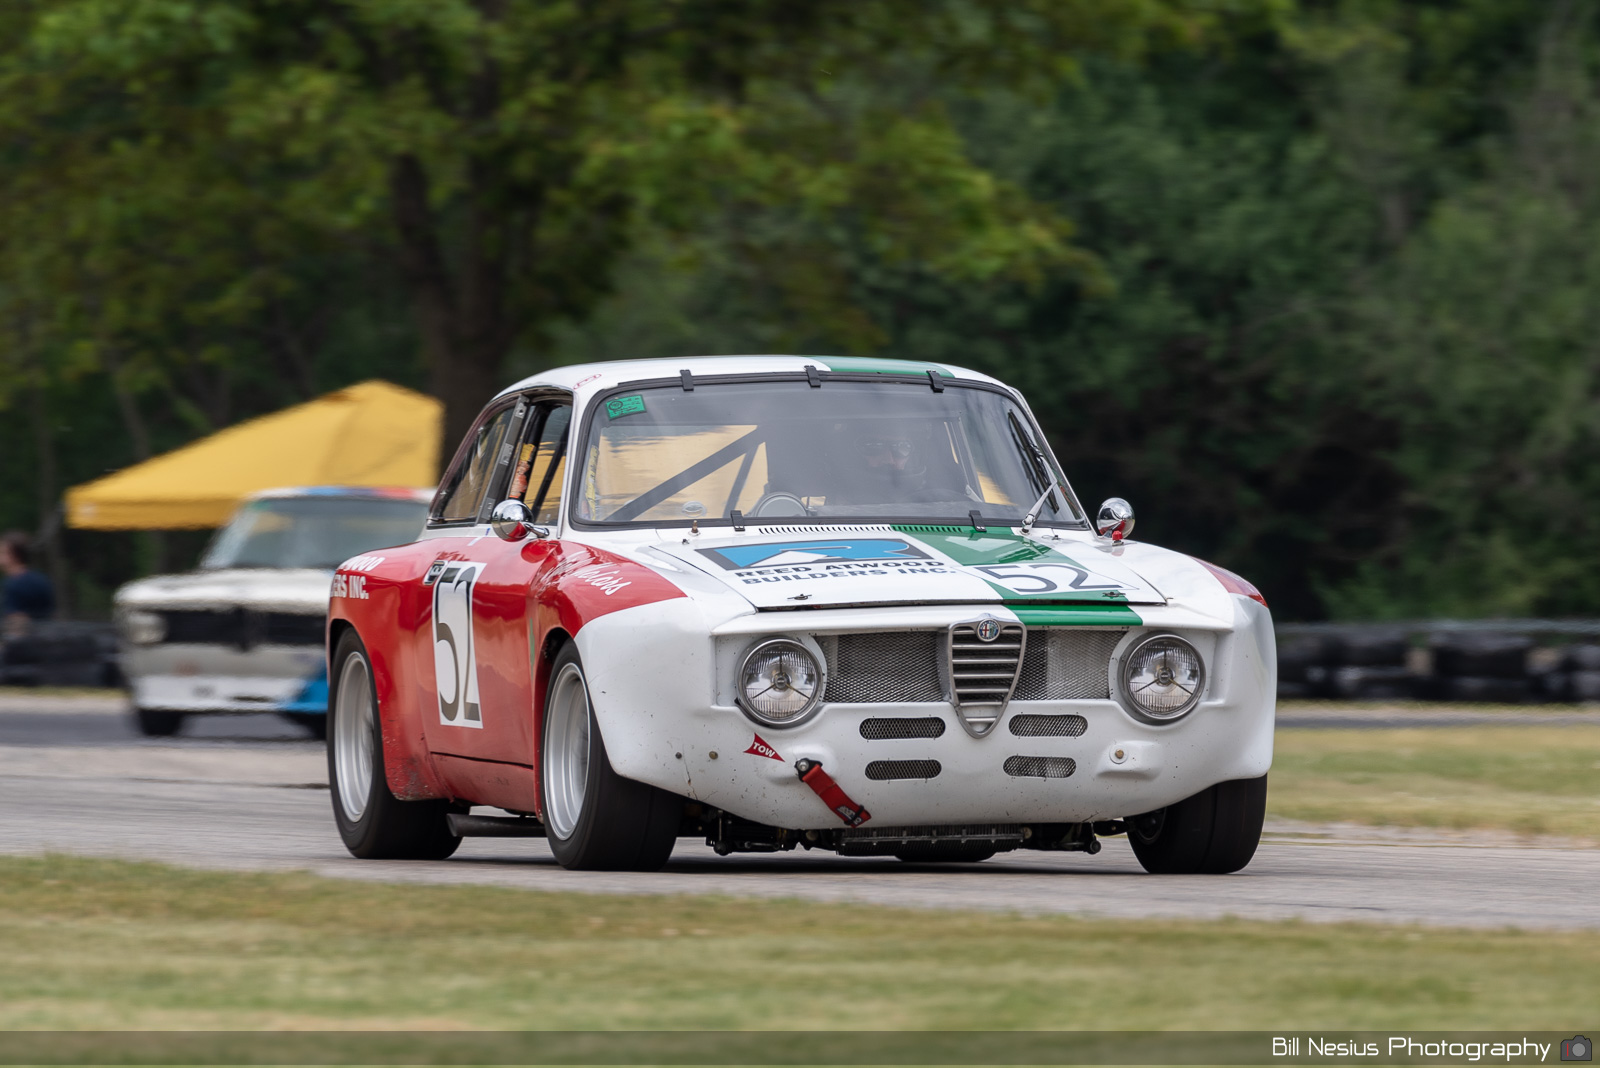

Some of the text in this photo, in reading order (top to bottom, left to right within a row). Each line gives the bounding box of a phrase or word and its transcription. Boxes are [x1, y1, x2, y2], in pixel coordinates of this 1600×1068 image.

[735, 561, 945, 578] REED ATWOOD
[741, 567, 958, 585] BUILDERS INC.
[978, 563, 1124, 594] 52
[348, 575, 370, 600] INC.
[435, 566, 481, 721] 52
[753, 742, 776, 758] TOW
